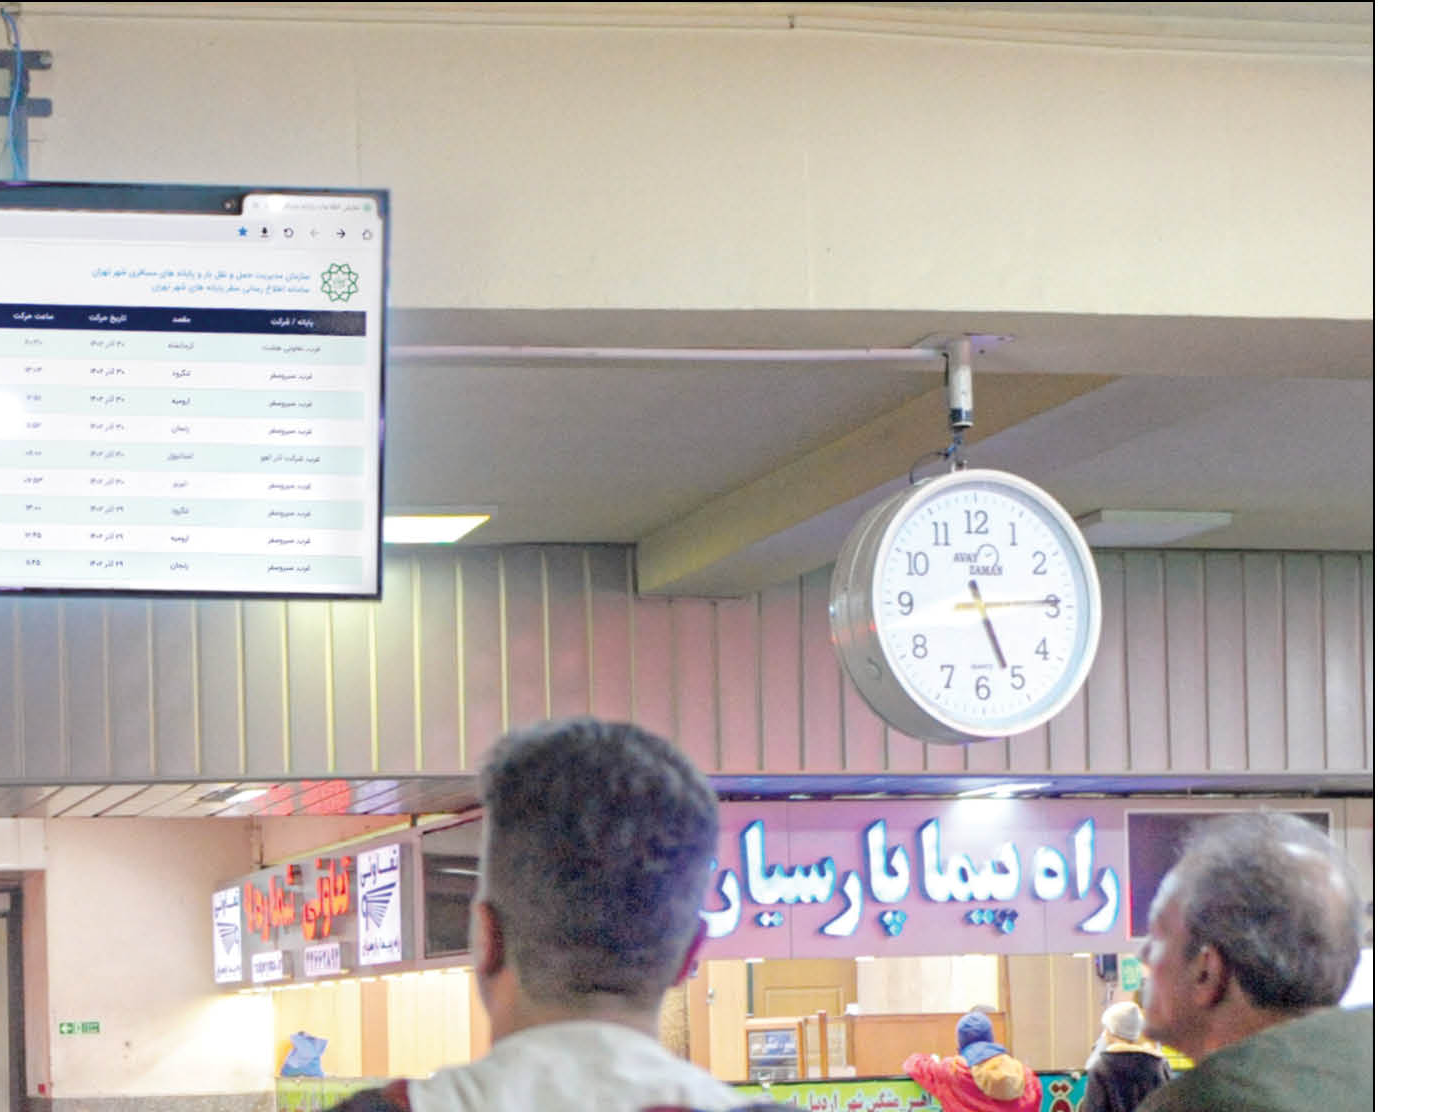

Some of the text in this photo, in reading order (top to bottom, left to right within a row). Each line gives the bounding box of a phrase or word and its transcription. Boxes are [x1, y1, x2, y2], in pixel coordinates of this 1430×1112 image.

[931, 522, 951, 546] 11
[964, 510, 989, 534] 12
[1009, 522, 1018, 546] 1
[906, 551, 930, 576] 10
[1031, 551, 1048, 575] 2
[897, 591, 914, 616] 9
[1044, 594, 1060, 618] 3
[911, 634, 928, 659] 8
[1035, 637, 1049, 660] 4
[940, 664, 955, 688] 7
[975, 675, 991, 700] 6
[1010, 665, 1026, 690] 5
[700, 817, 1120, 938] راه پیما پارسیان
